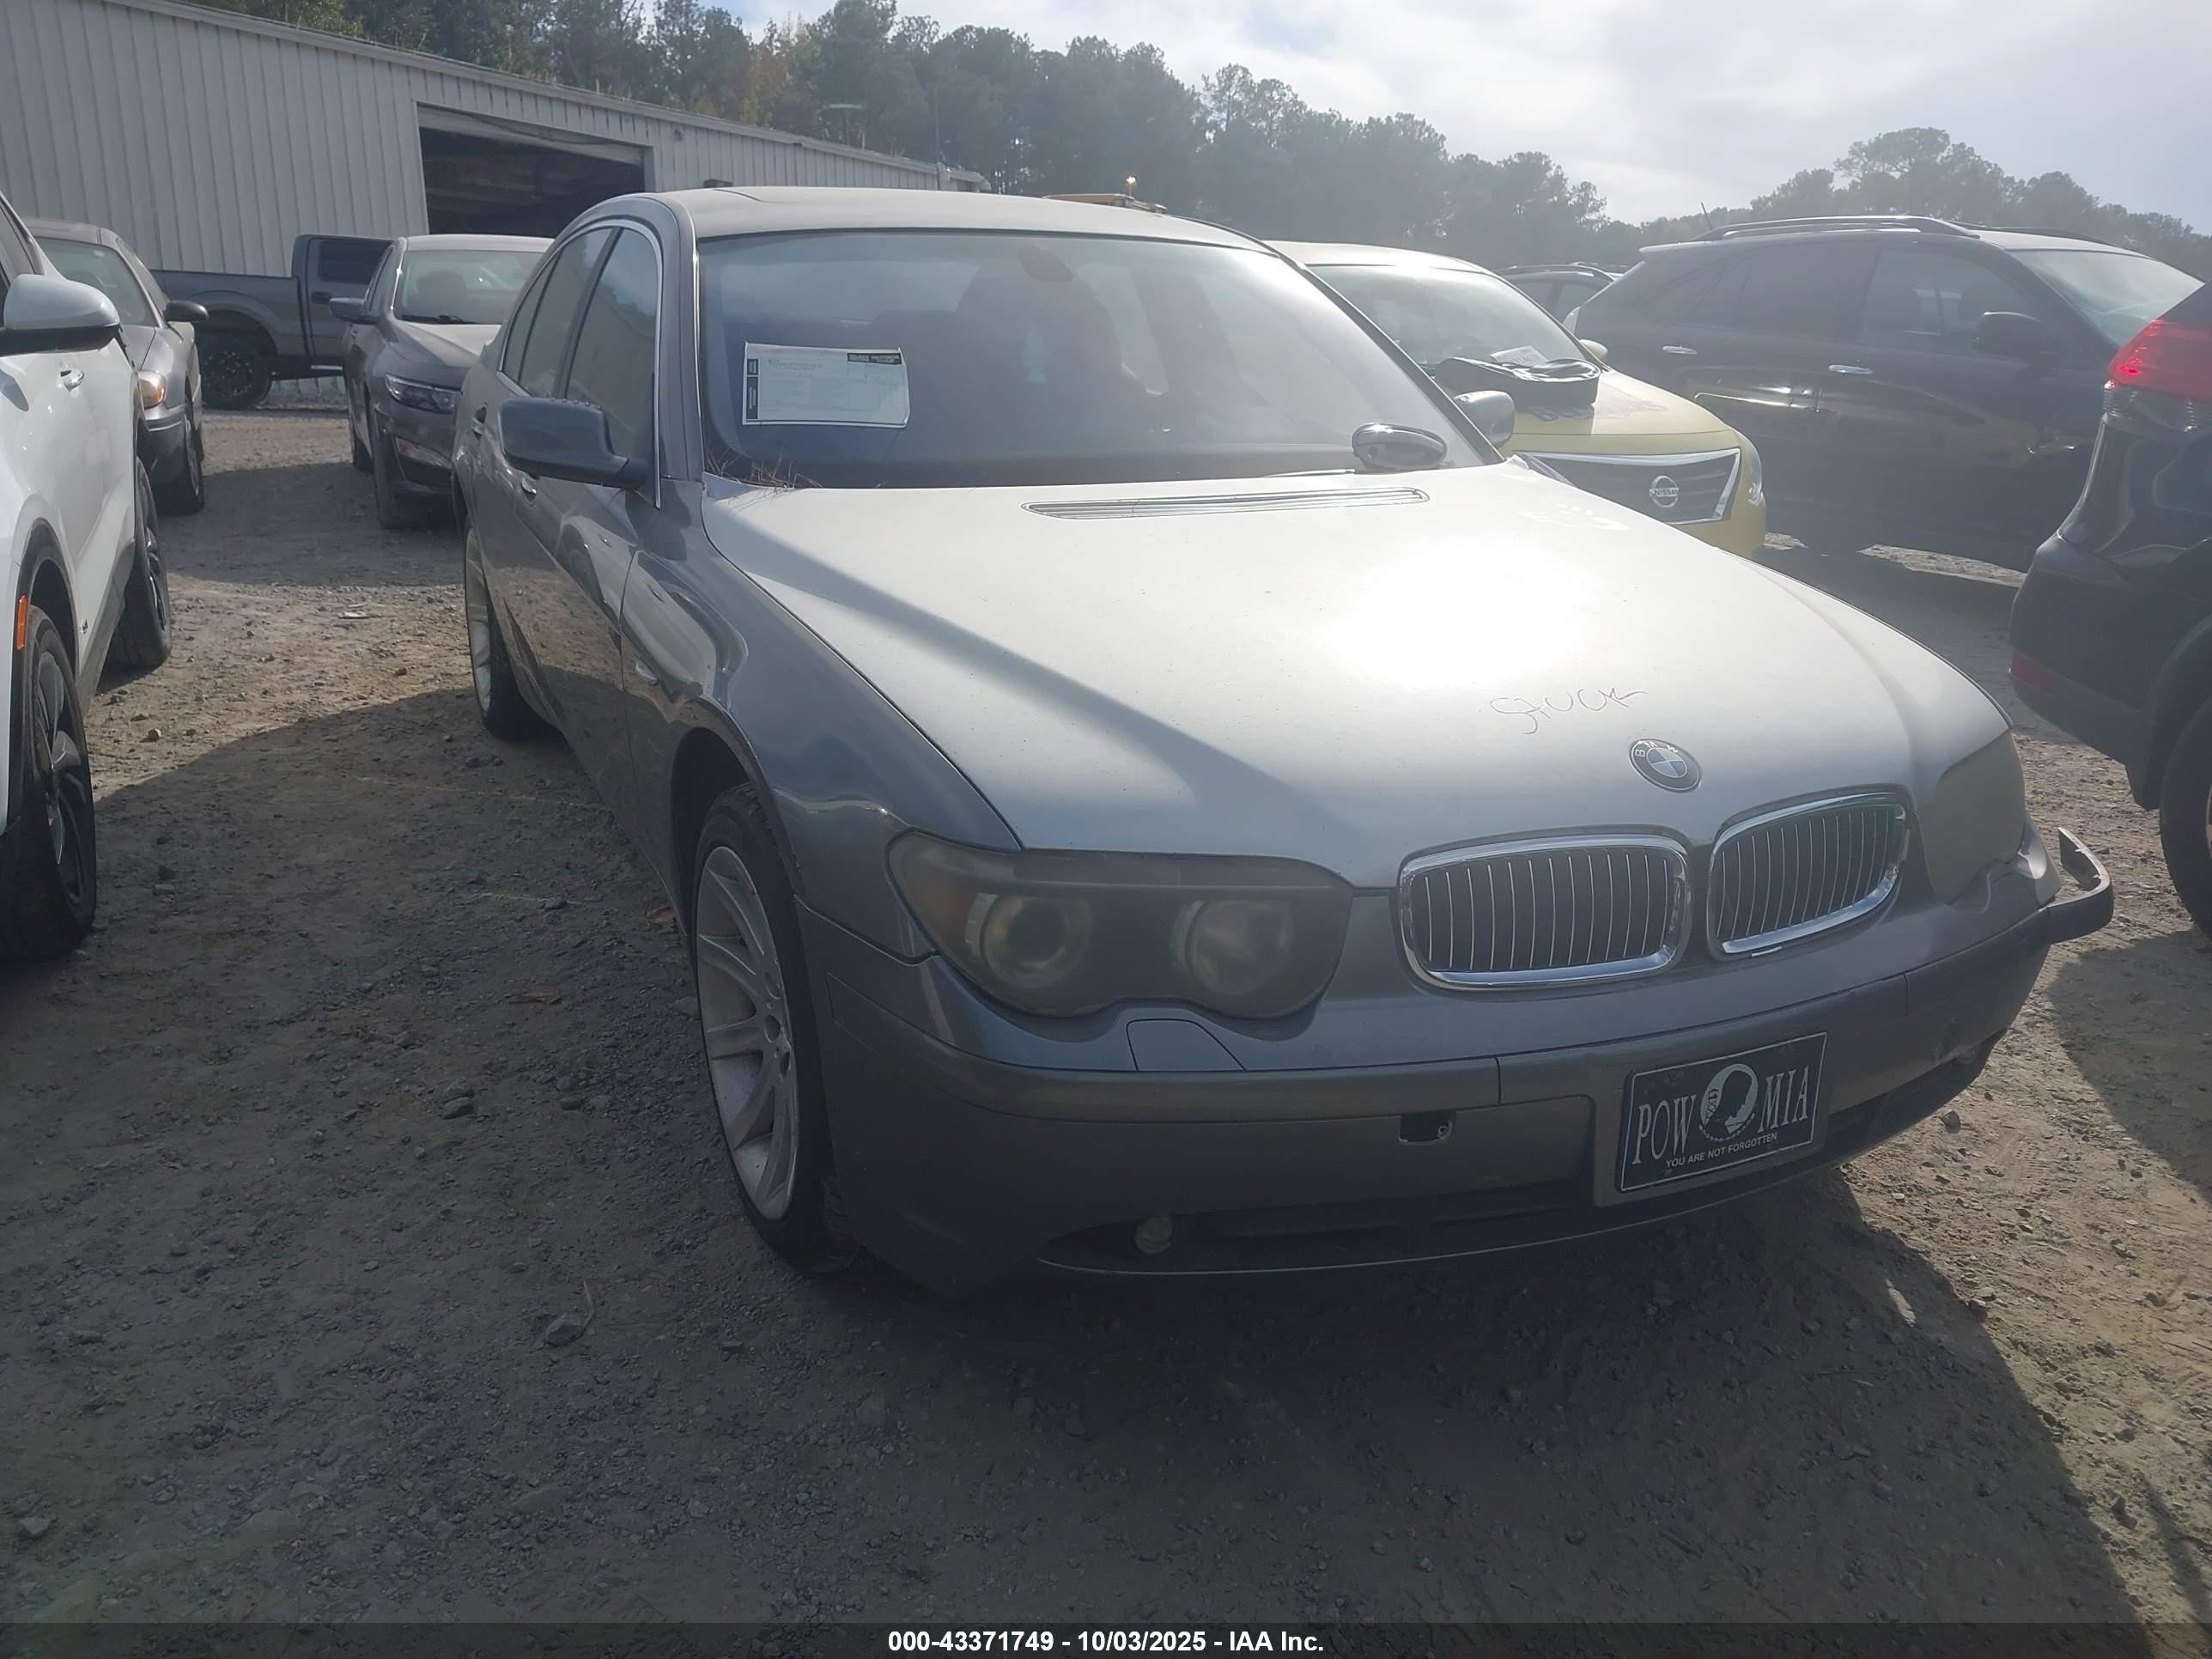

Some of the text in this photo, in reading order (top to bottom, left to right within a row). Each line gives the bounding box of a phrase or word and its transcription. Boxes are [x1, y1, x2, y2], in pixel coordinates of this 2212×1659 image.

[1634, 740, 1680, 757] BMW
[1632, 1065, 1809, 1164] POW MIA
[1666, 1133, 1778, 1169] YOU ARE NOT FORGOTTEN
